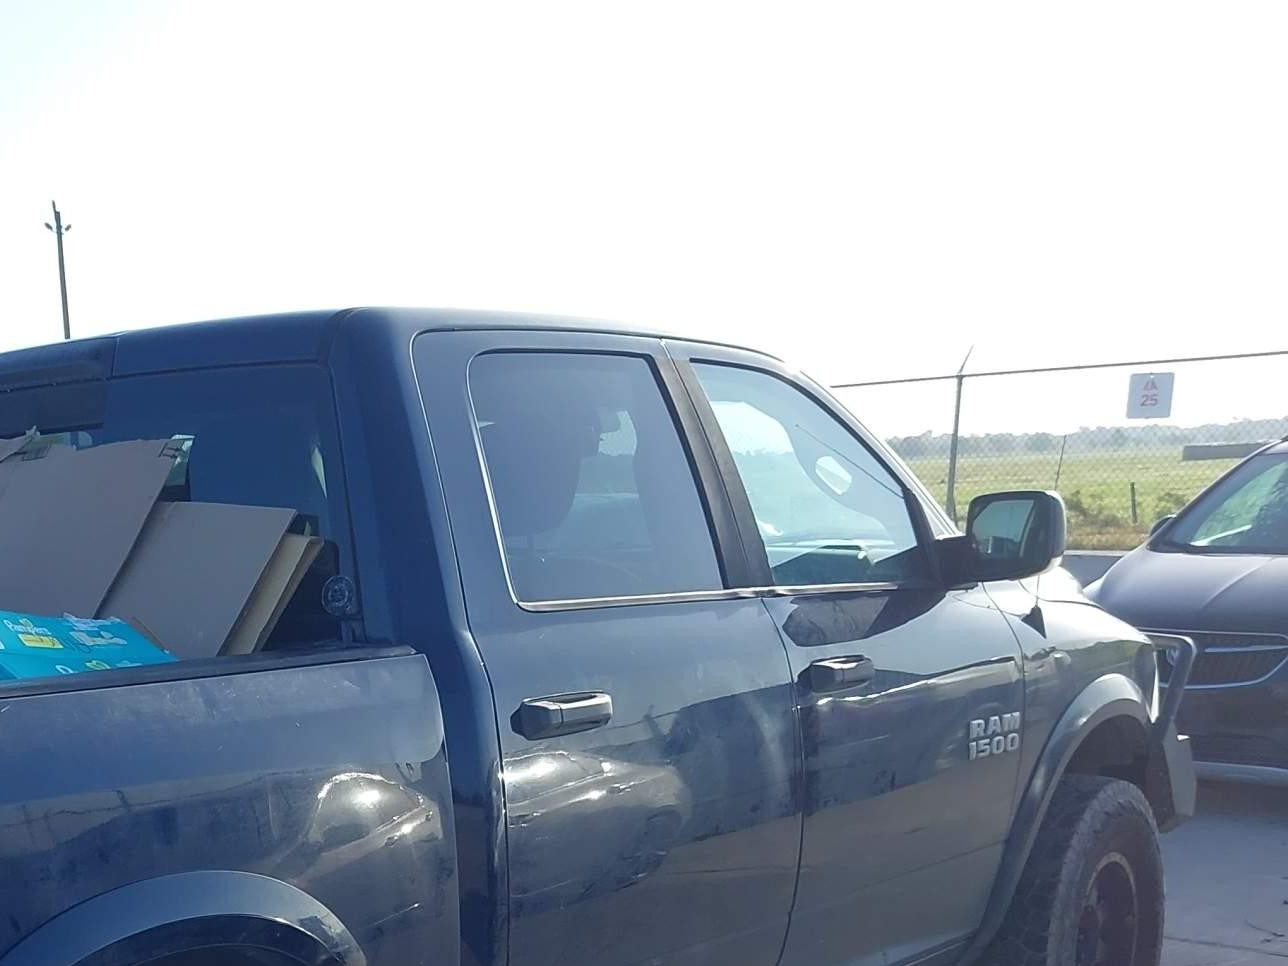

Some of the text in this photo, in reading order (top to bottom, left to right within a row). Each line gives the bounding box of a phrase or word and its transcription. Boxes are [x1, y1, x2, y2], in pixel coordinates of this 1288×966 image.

[1140, 394, 1159, 407] 25
[969, 711, 1020, 740] RAM
[968, 732, 1019, 761] 1500
